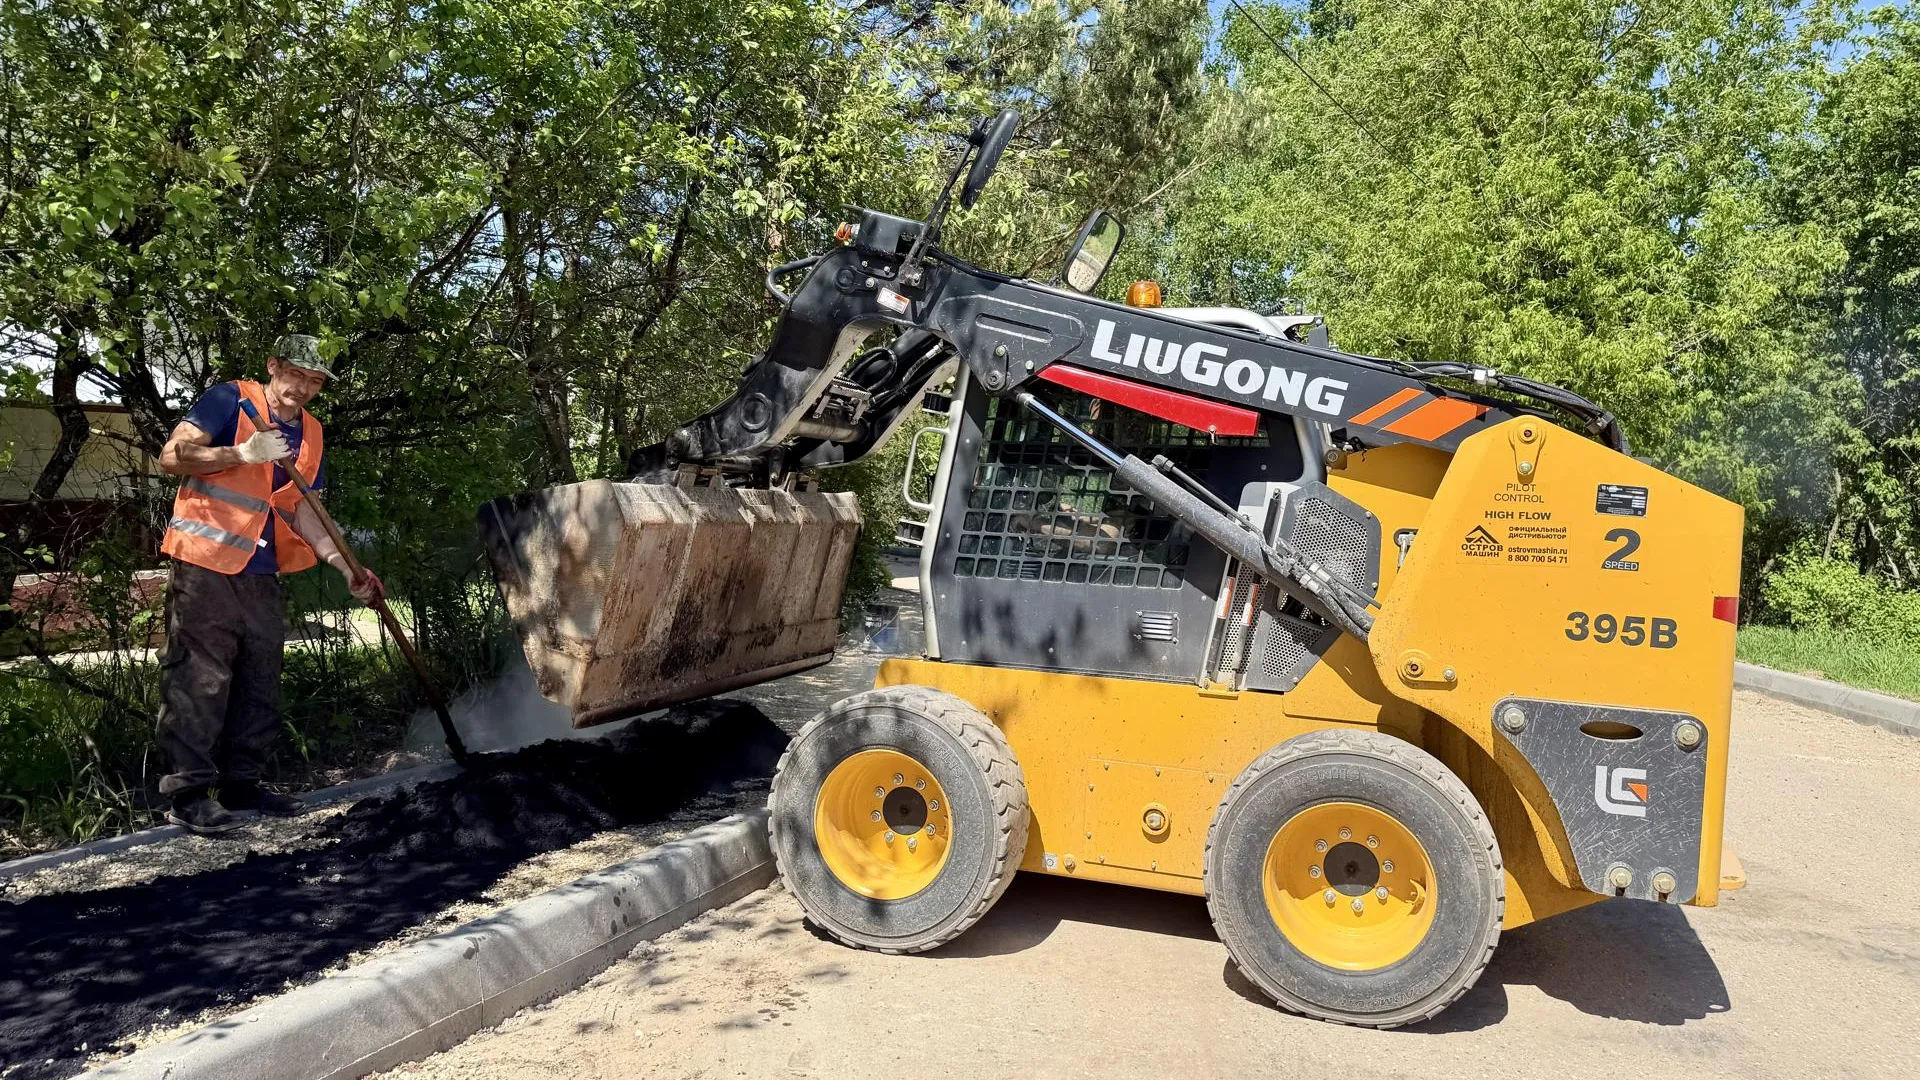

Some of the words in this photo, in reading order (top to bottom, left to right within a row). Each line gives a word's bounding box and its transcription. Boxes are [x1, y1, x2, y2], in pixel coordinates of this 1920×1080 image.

[1506, 483, 1536, 492] PILOT
[1494, 493, 1545, 504] CONTROL
[1484, 510, 1514, 520] HIGH
[1518, 511, 1552, 521] FLOW
[1508, 532, 1567, 540] ДИСТРИБЬЮТОР
[1461, 543, 1504, 552] ОСТРОВ
[1508, 546, 1568, 555] ostrovmashin.ru
[1601, 528, 1641, 571] 2
[1508, 554, 1513, 562] 8
[1514, 554, 1529, 562] 800
[1531, 555, 1546, 563] 700
[1559, 556, 1568, 564] 71
[1604, 560, 1638, 570] SPEED
[1564, 611, 1679, 649] 395B
